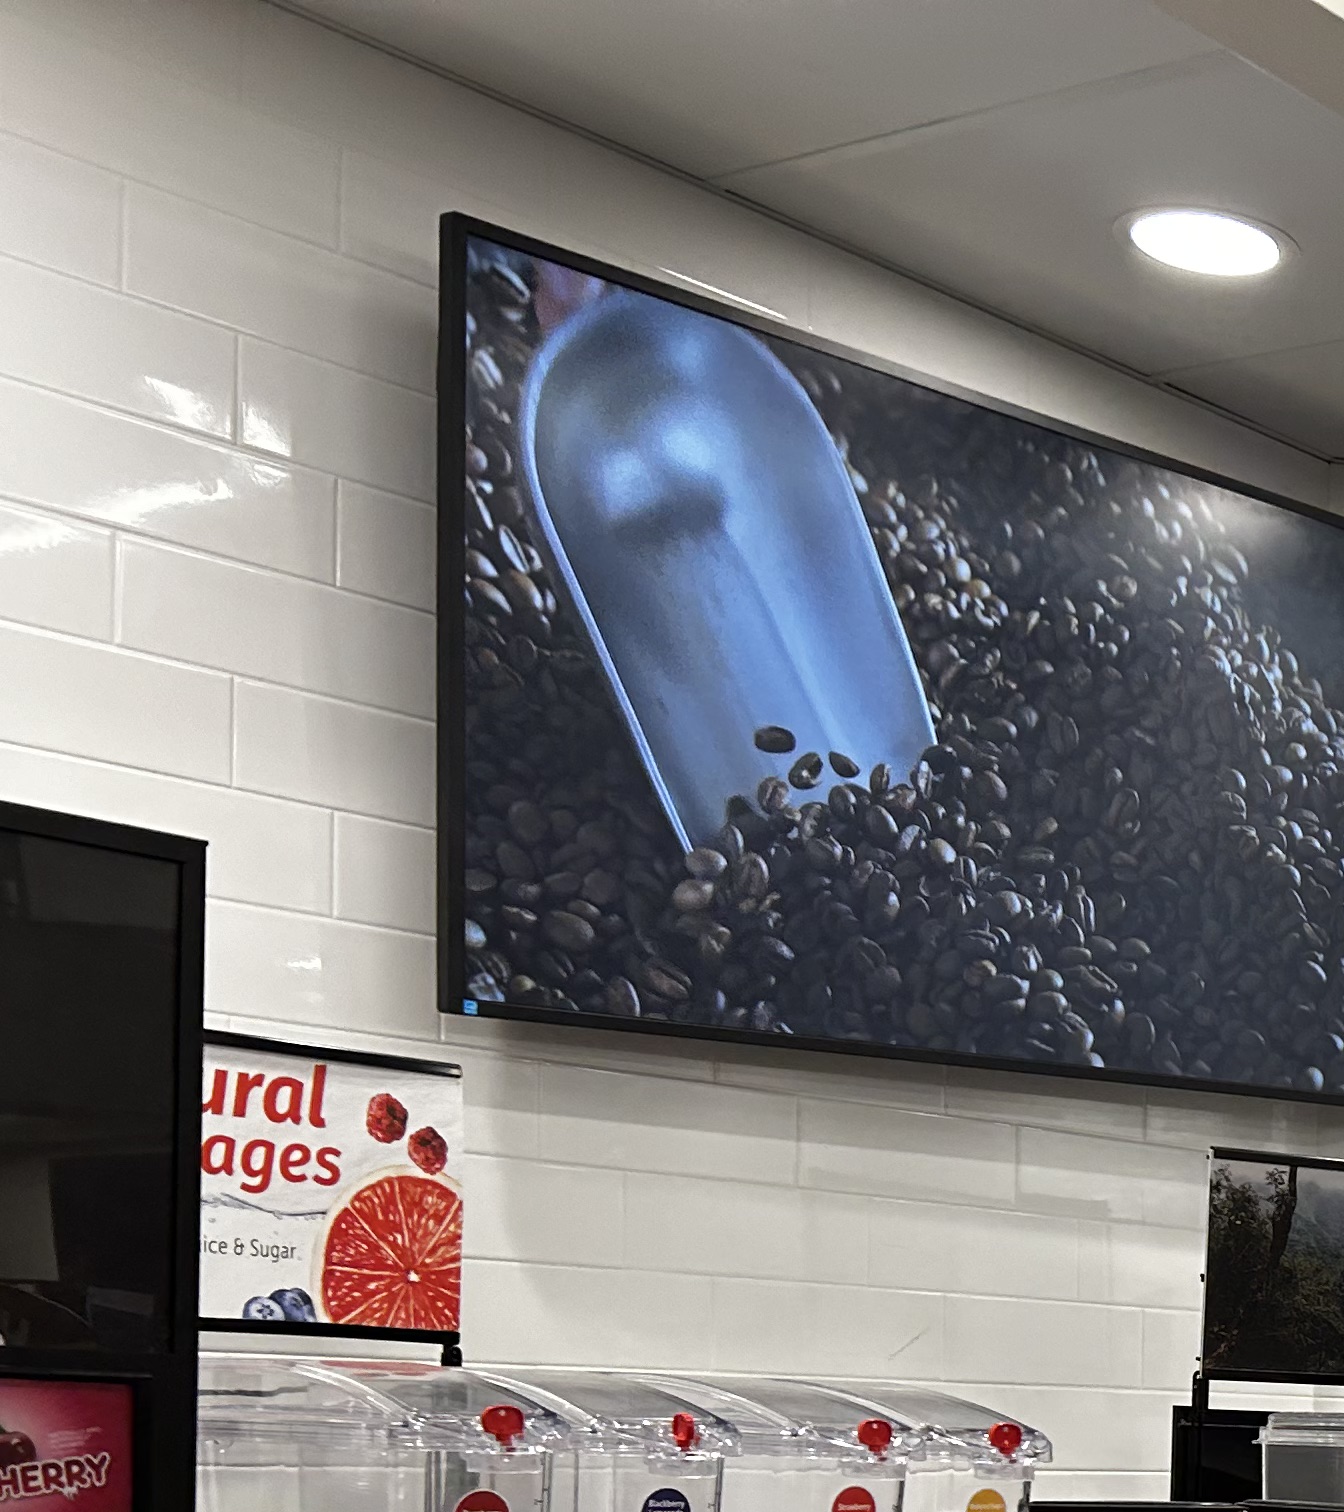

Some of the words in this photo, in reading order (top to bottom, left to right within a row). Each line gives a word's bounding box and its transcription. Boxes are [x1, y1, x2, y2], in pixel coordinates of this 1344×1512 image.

[201, 1135, 342, 1194] ages
[234, 1238, 244, 1256] &
[250, 1238, 297, 1263] Sugar
[648, 1500, 685, 1509] Blackberry
